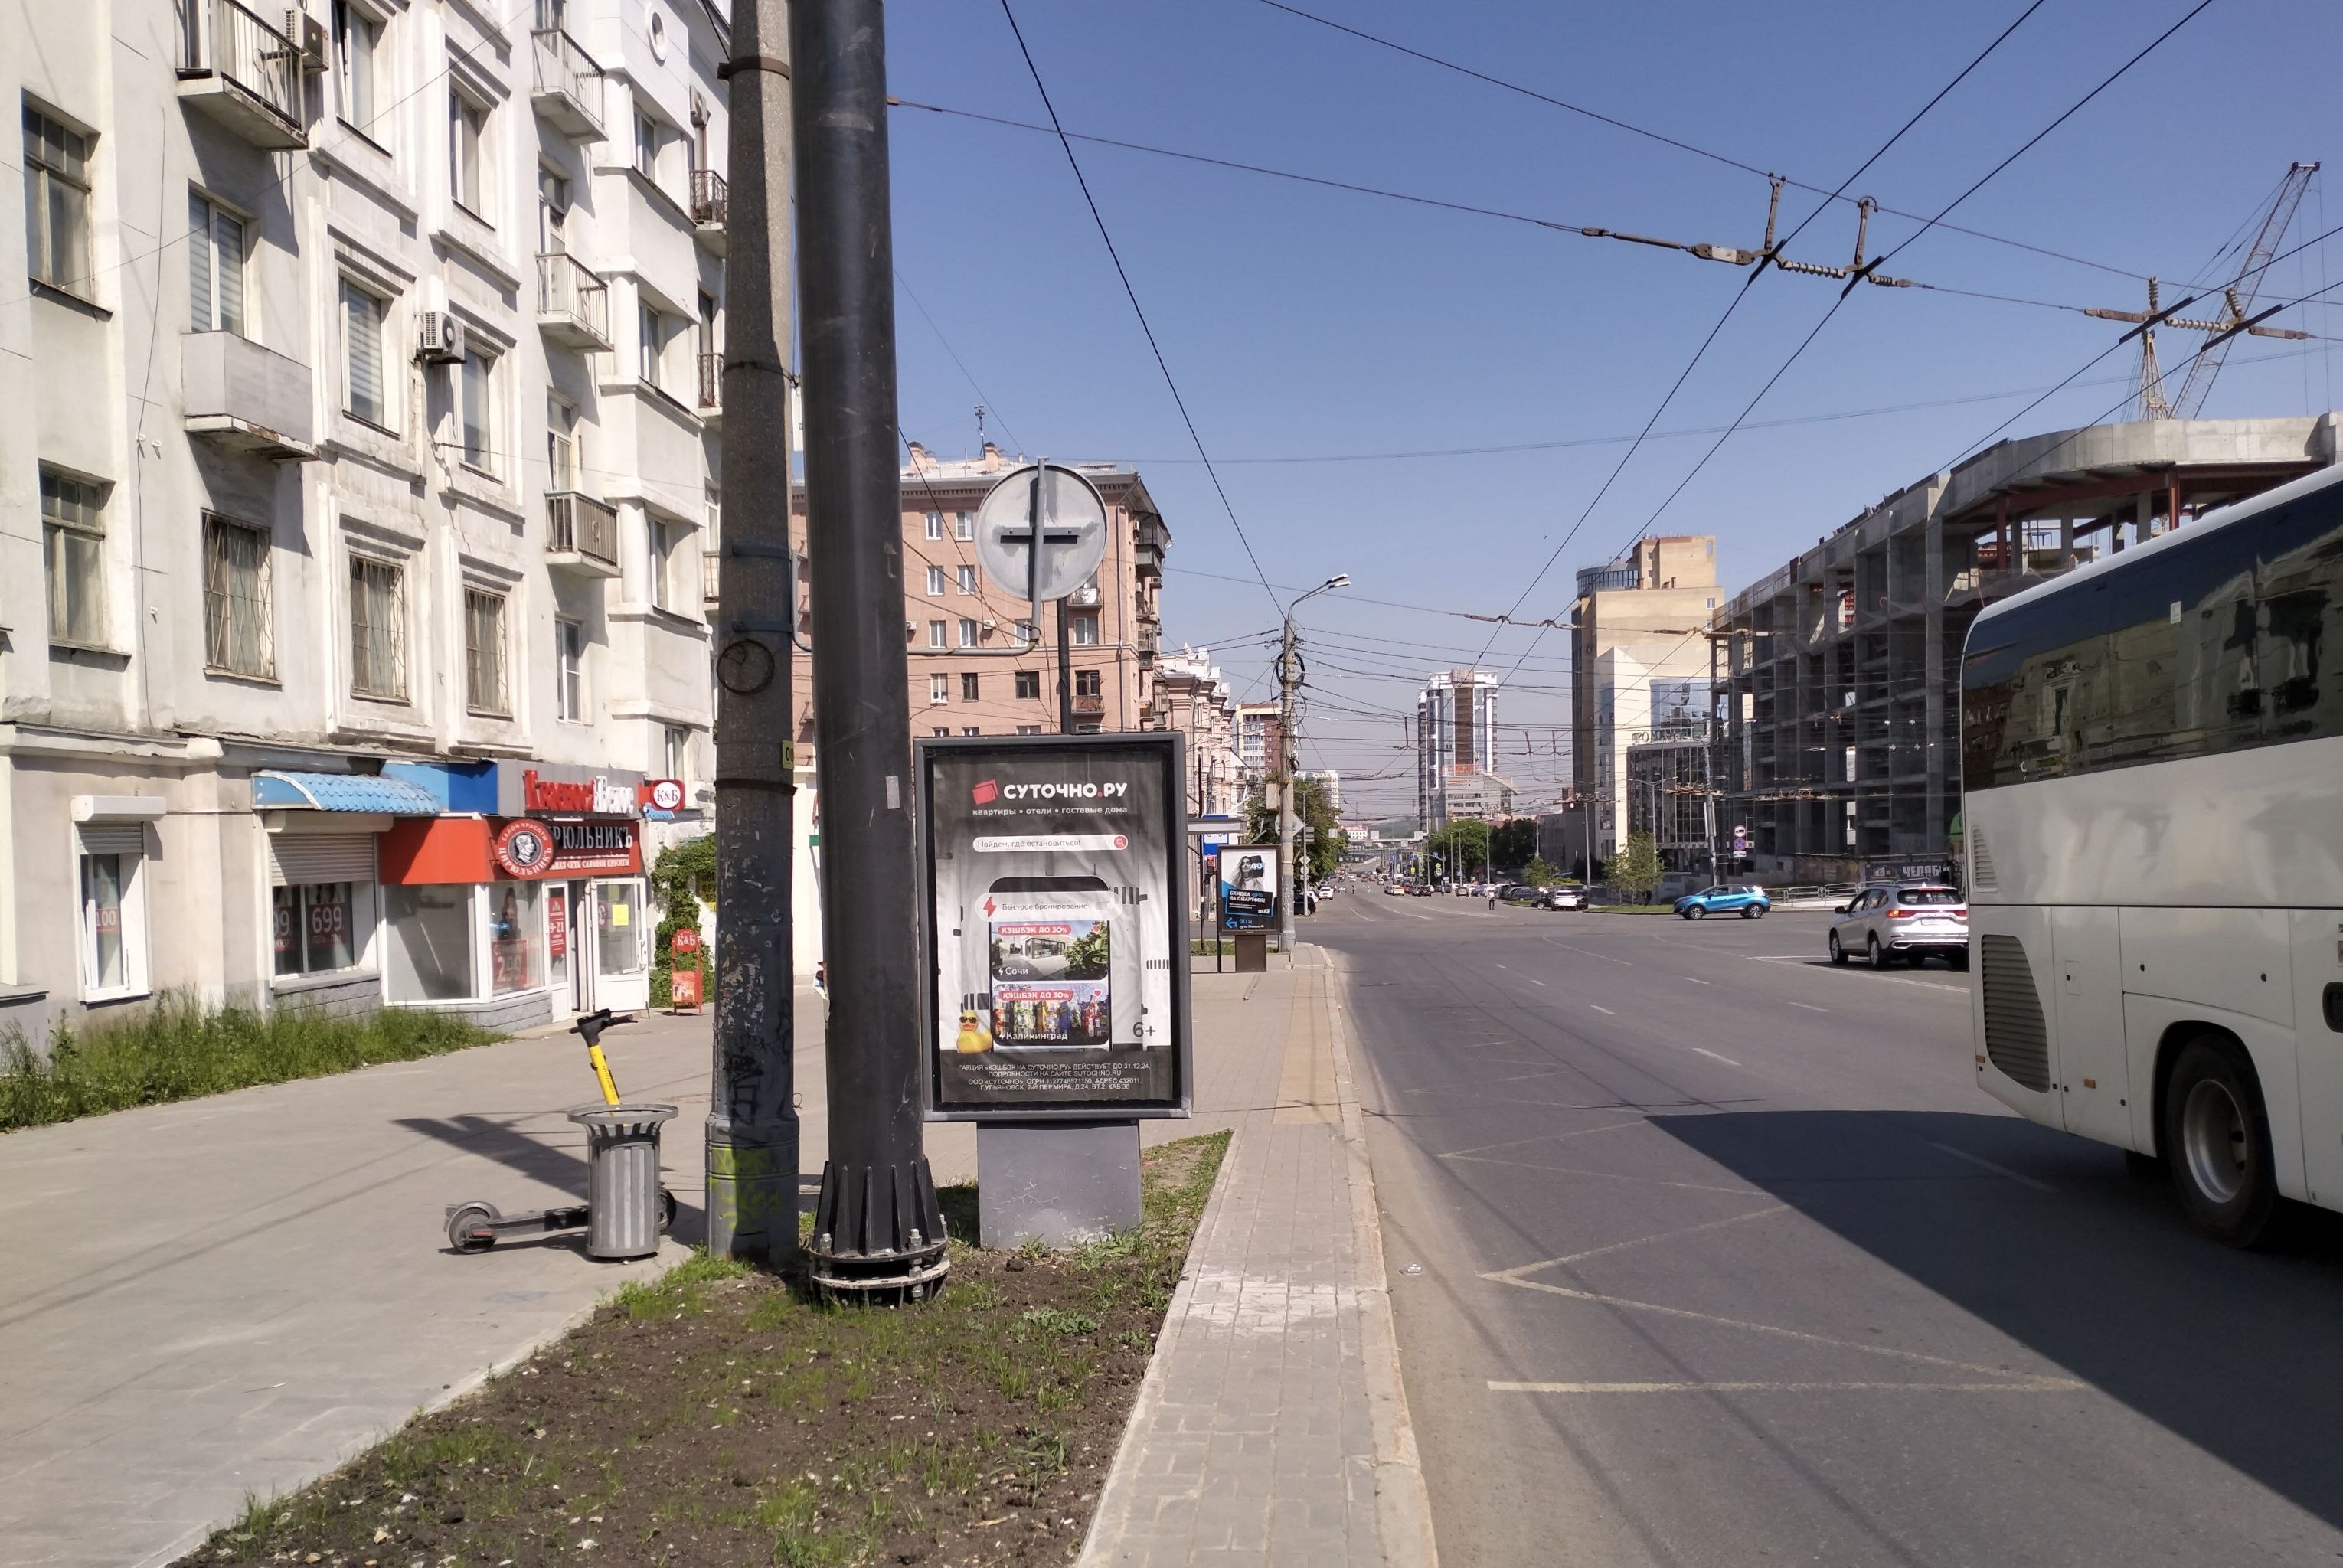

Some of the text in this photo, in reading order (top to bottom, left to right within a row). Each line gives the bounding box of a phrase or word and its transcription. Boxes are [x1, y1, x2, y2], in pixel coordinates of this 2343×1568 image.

[657, 789, 678, 802] К&Б
[1003, 782, 1128, 799] СУТОЧНО.РУ
[972, 808, 1017, 817] квартиры
[1104, 806, 1128, 815] дома
[553, 826, 633, 849] РЮЛЬНИКЪ
[498, 848, 552, 876] ЦИРЮЛЬНИКЪ
[1034, 903, 1089, 911] бронирование
[312, 906, 343, 933] 699
[1002, 926, 1068, 934] КЭШБЭК ДО 30%
[677, 935, 696, 946] К&Б
[1005, 966, 1028, 975] Сочи
[1003, 991, 1037, 1000] КЭШБЭК
[1040, 991, 1051, 1000] ДО
[1132, 1022, 1156, 1037] 6+
[1006, 1031, 1068, 1041] Калининград
